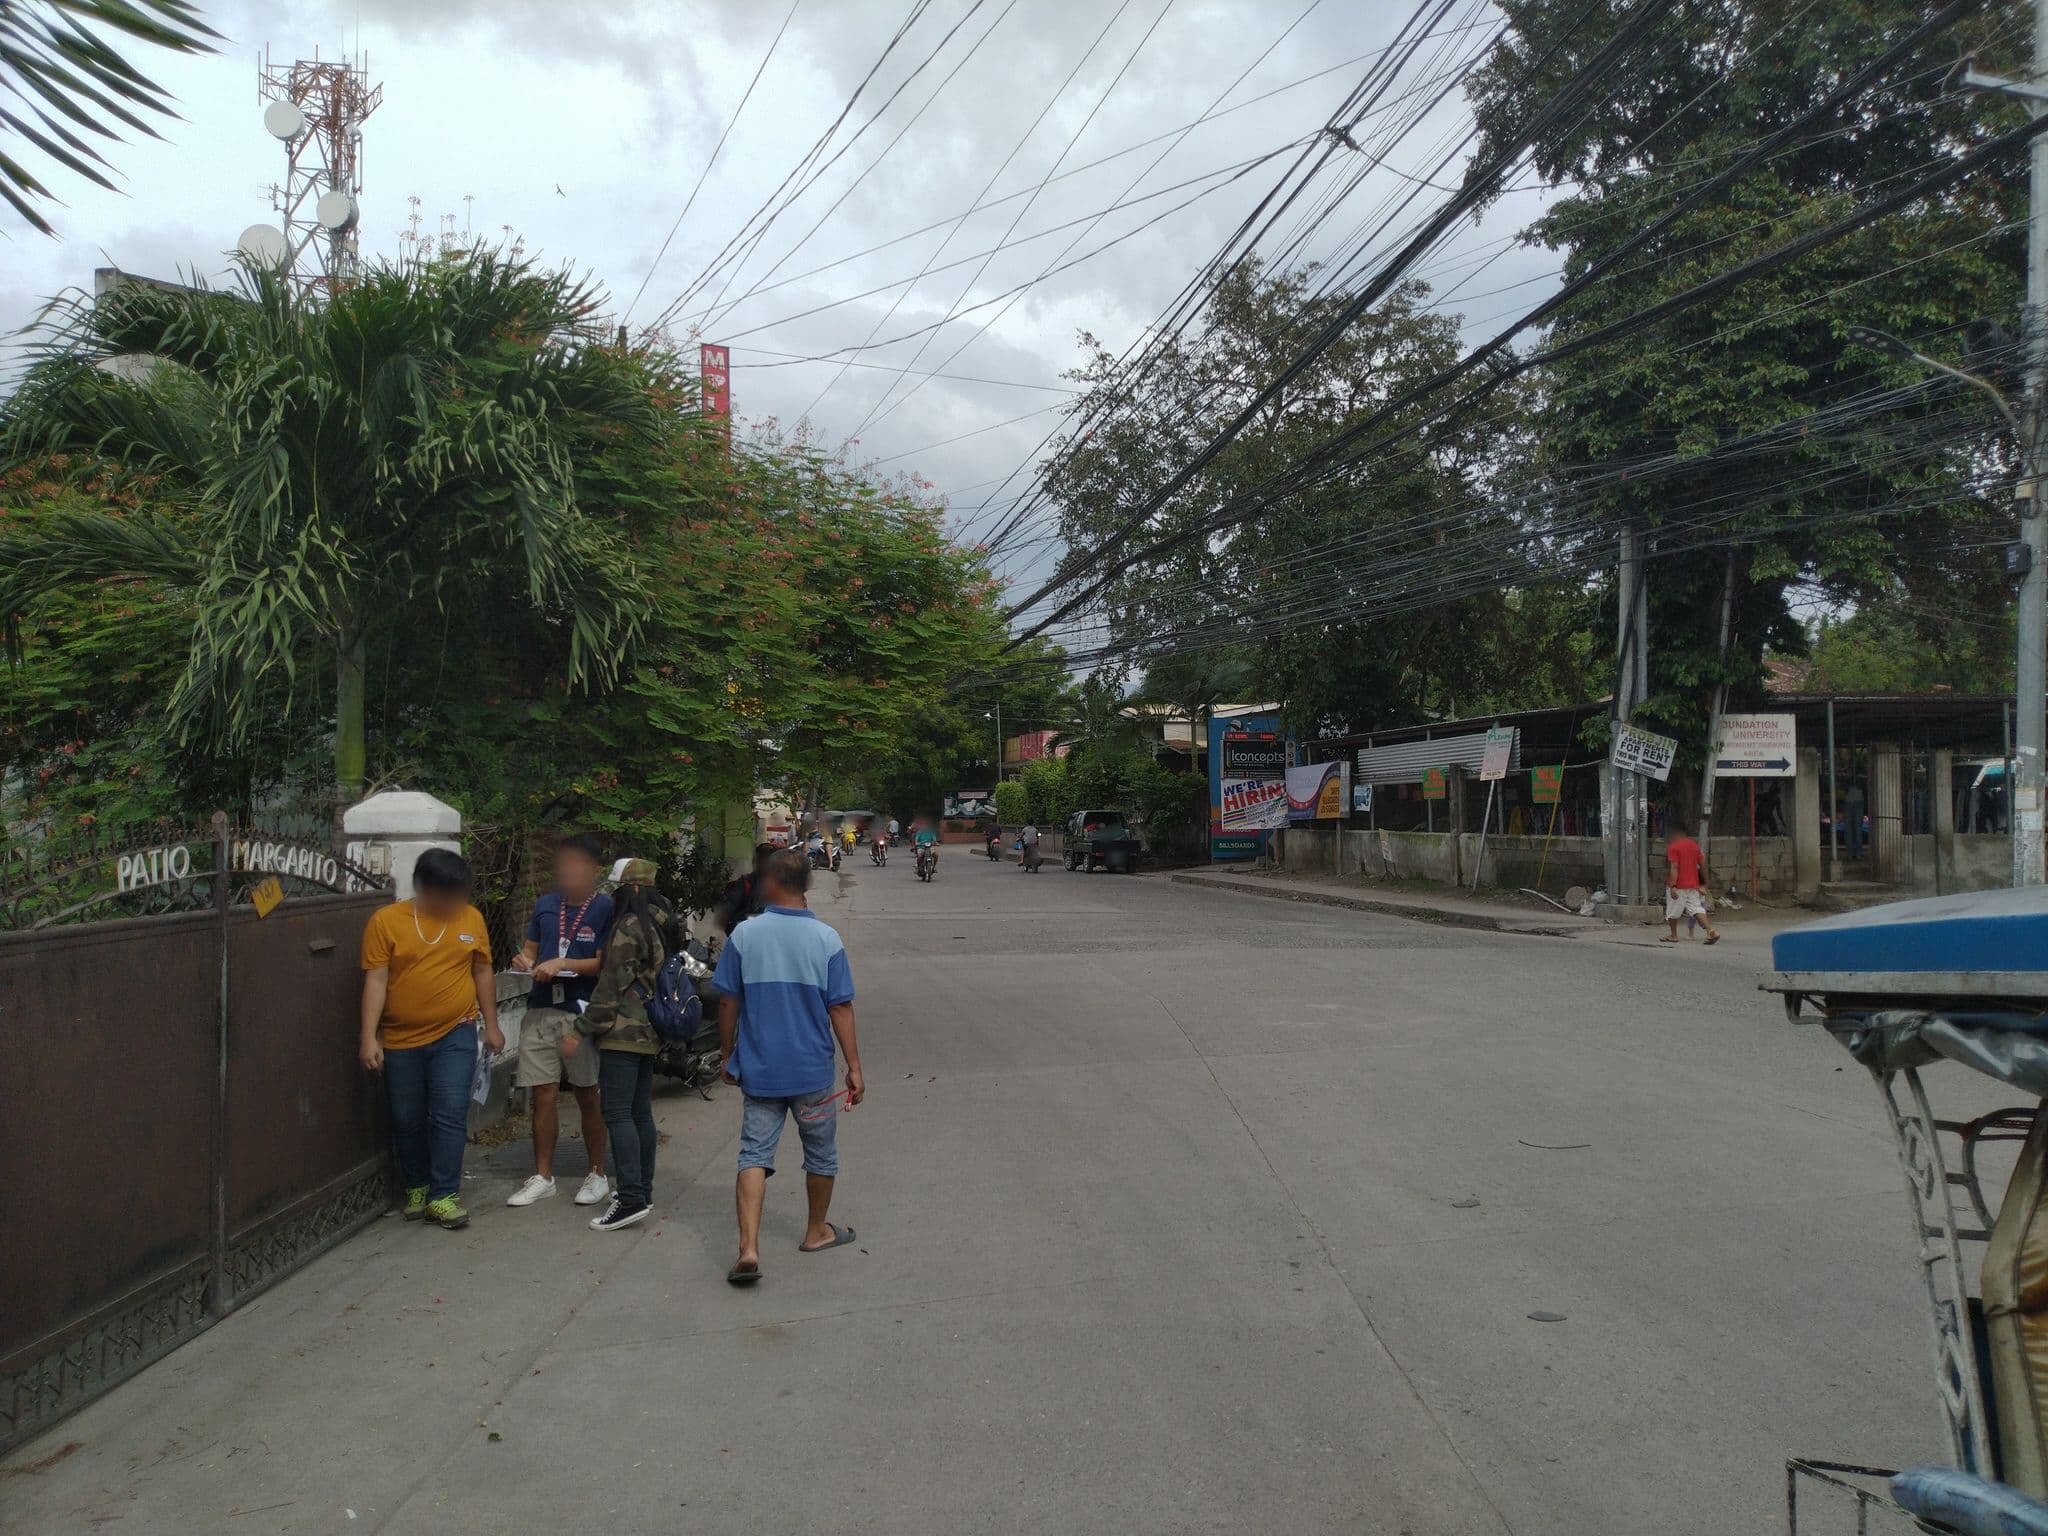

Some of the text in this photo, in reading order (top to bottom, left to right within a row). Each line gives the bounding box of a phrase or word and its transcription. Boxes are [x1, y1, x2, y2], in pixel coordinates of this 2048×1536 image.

[1721, 720, 1778, 729] OUNDATION
[1733, 731, 1791, 739] UNIVERSITY
[1620, 741, 1671, 763] FOR RENT
[1623, 736, 1669, 755] APARTMENTS
[1224, 780, 1264, 797] WE'RE
[1224, 783, 1286, 812] HIRIN
[118, 839, 338, 892] PATIO MARGARITO
